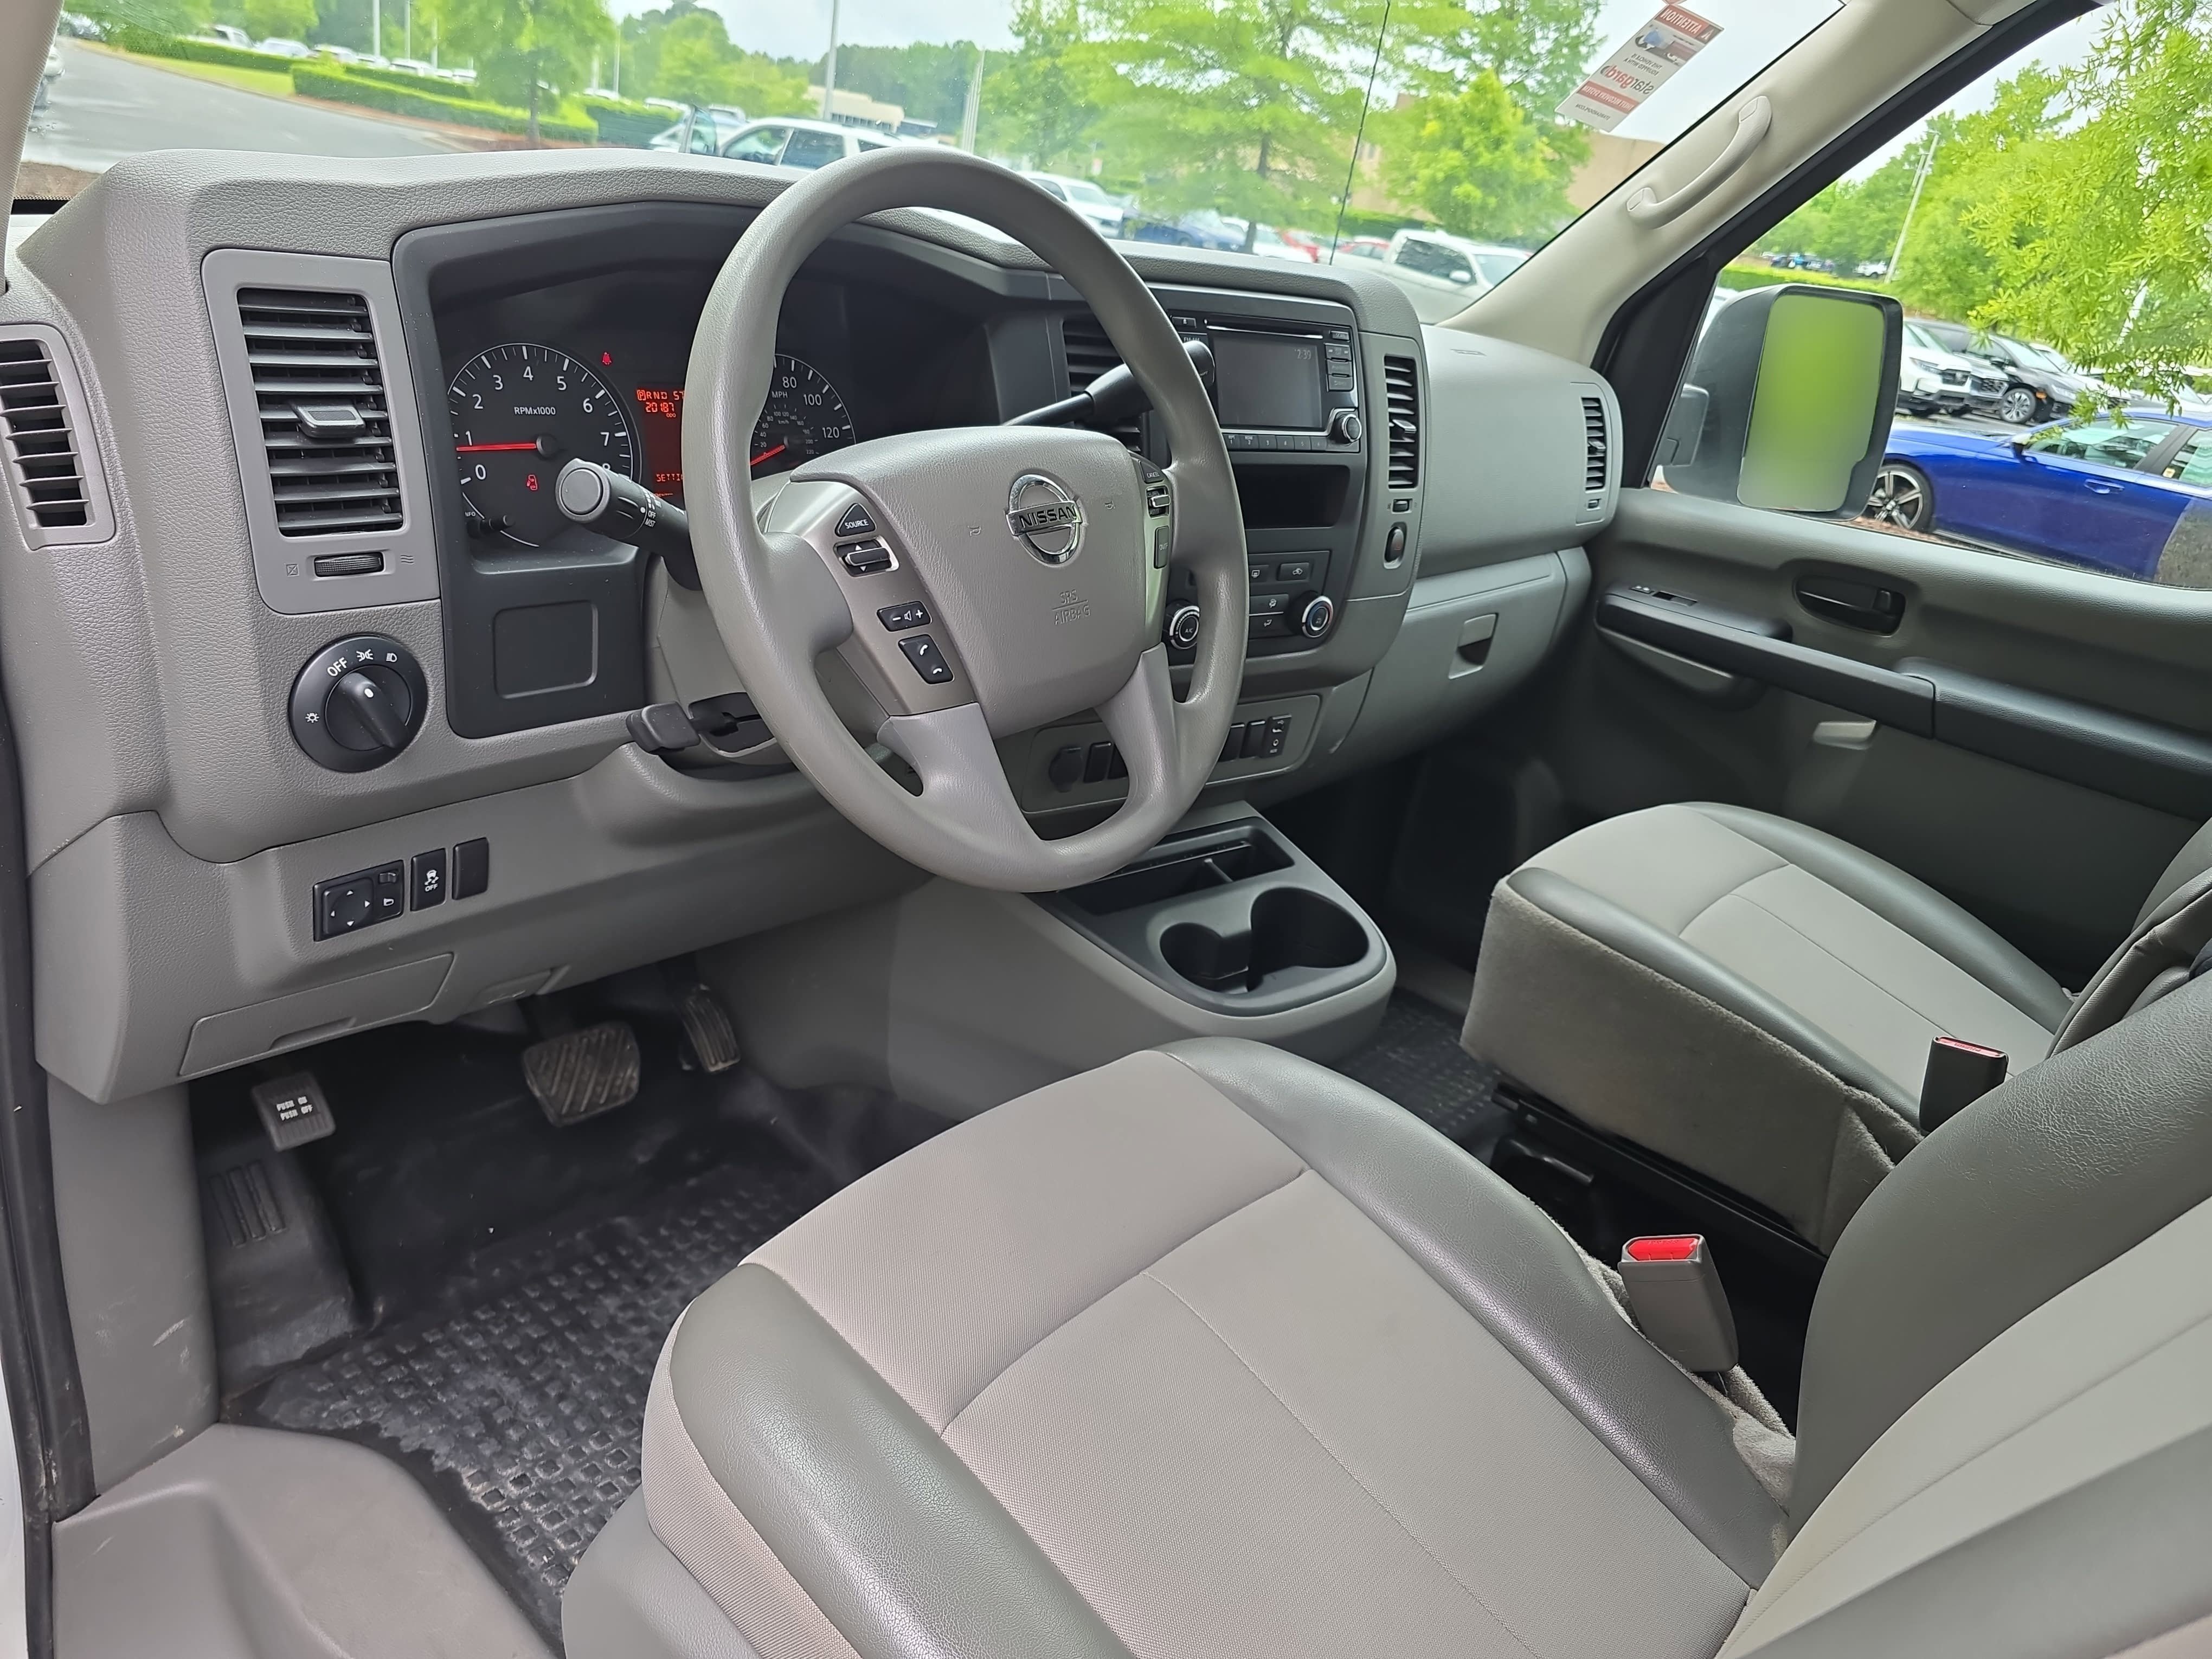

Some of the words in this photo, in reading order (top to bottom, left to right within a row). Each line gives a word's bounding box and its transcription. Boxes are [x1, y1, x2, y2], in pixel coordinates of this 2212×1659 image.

[523, 366, 533, 381] 4
[493, 375, 503, 390] 3
[557, 376, 567, 390] 5
[782, 376, 797, 388] 80
[472, 394, 484, 409] 2
[583, 398, 593, 413] 6
[803, 394, 822, 406] 100
[514, 407, 556, 415] RPMx1000
[465, 430, 473, 446] 1
[600, 432, 609, 446] 7
[822, 427, 839, 438] 120
[475, 464, 486, 480] 0
[647, 510, 656, 519] OFF
[1019, 506, 1077, 529] NISSAN
[645, 518, 655, 528] MIST
[845, 519, 869, 529] SOURCE
[326, 657, 348, 678] OFF
[425, 883, 438, 892] OFF
